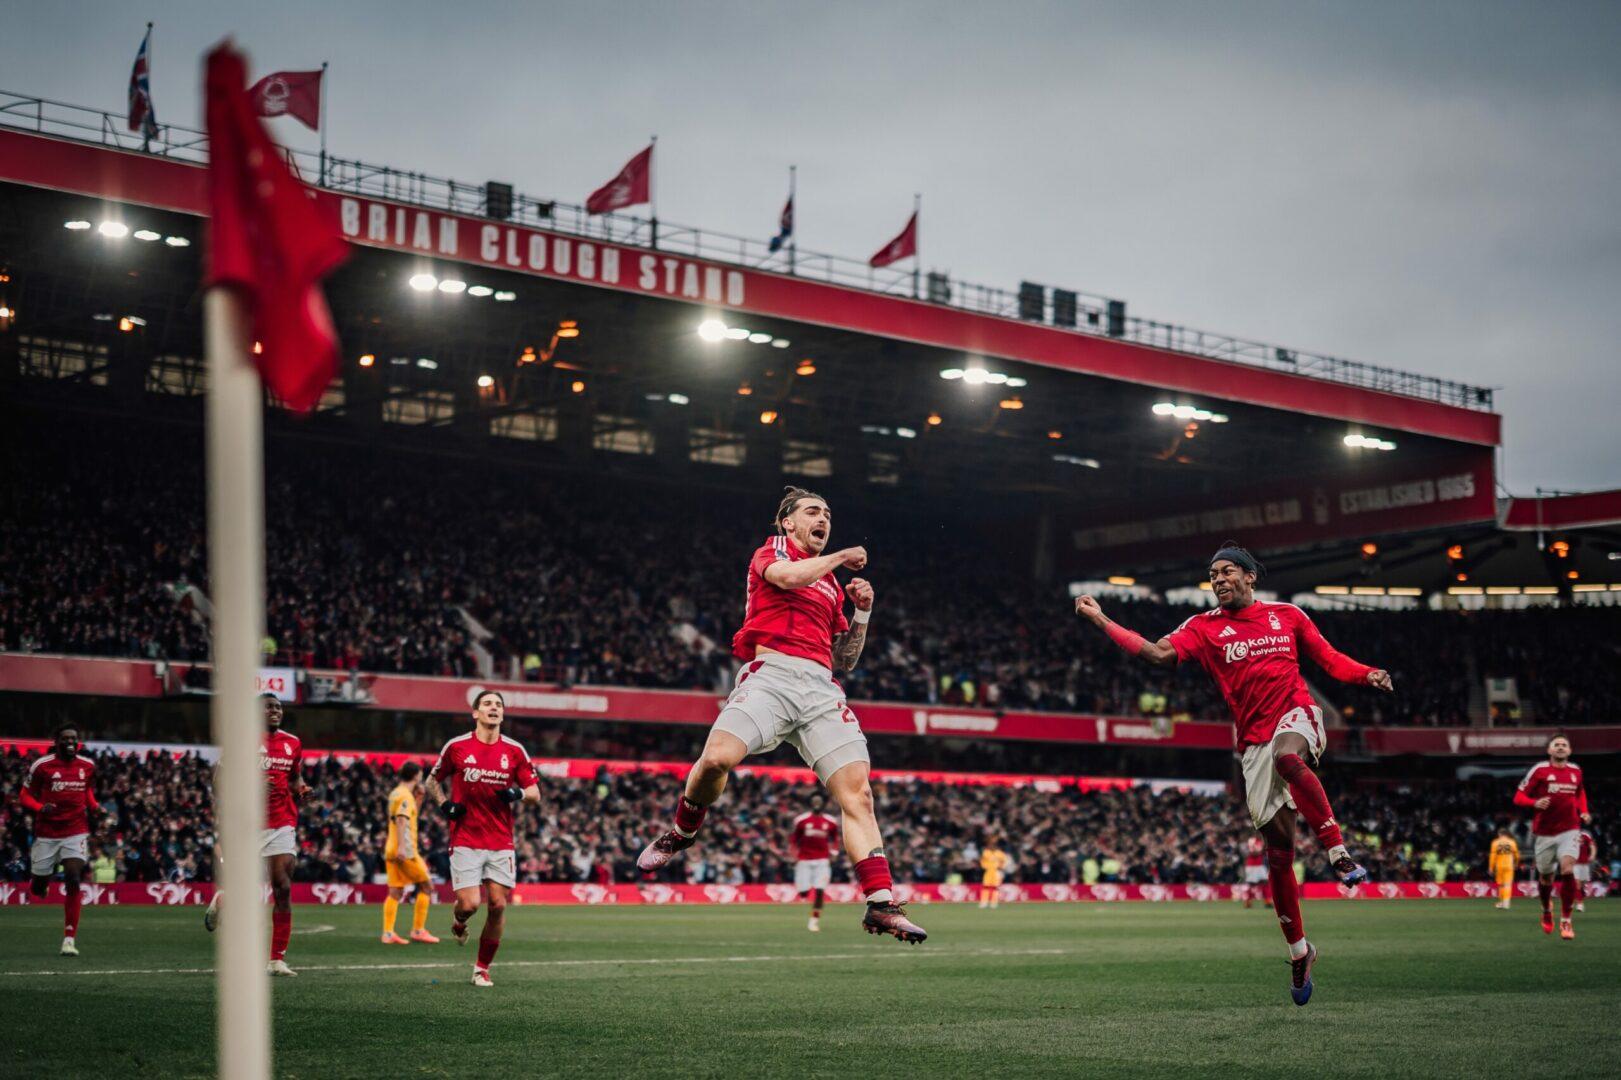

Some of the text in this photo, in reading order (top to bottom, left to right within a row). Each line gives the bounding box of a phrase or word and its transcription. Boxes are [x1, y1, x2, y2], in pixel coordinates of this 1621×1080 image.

[341, 198, 744, 306] BRIAN CLOUGH STAND
